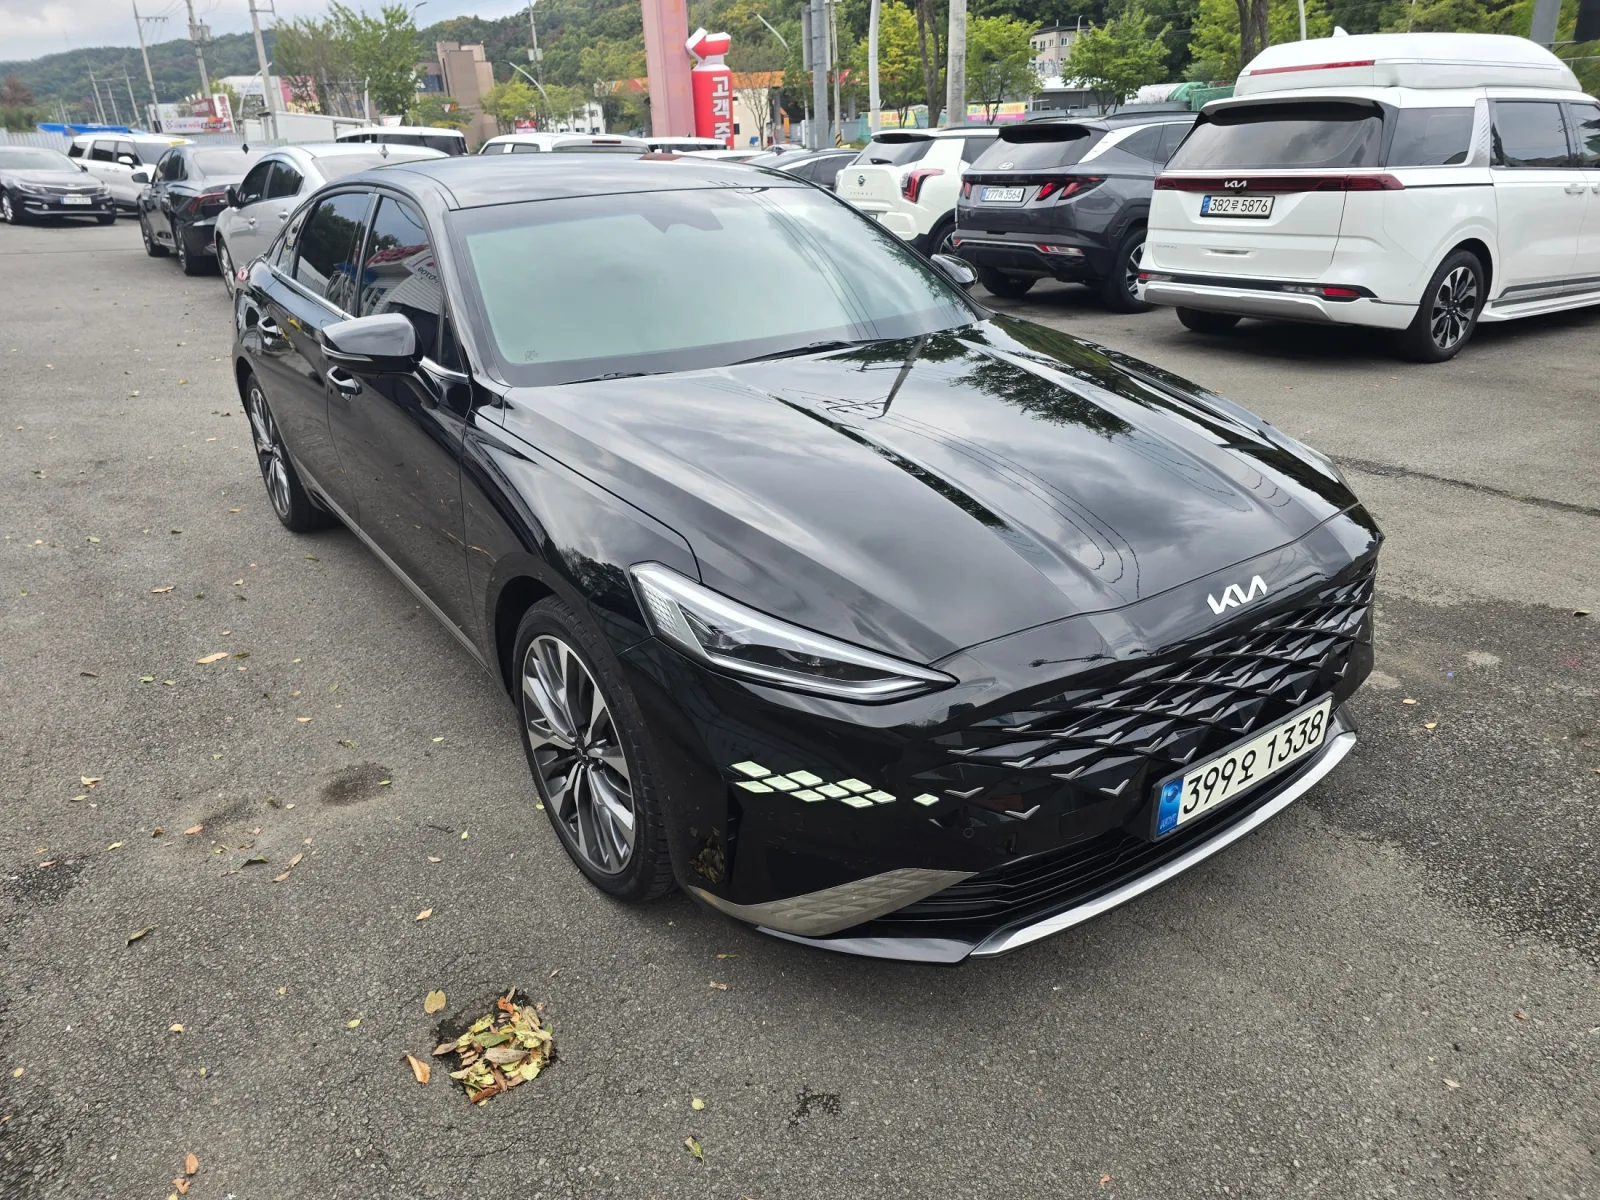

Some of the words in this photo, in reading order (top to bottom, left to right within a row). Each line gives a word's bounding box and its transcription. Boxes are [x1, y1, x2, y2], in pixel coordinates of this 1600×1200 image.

[1224, 180, 1247, 188] KIA
[1003, 189, 1022, 200] 3564
[1210, 198, 1239, 212] 382루
[1240, 199, 1269, 213] 5876
[1207, 575, 1268, 615] KIA
[1183, 749, 1257, 815] 399오
[1267, 709, 1324, 769] 1338
